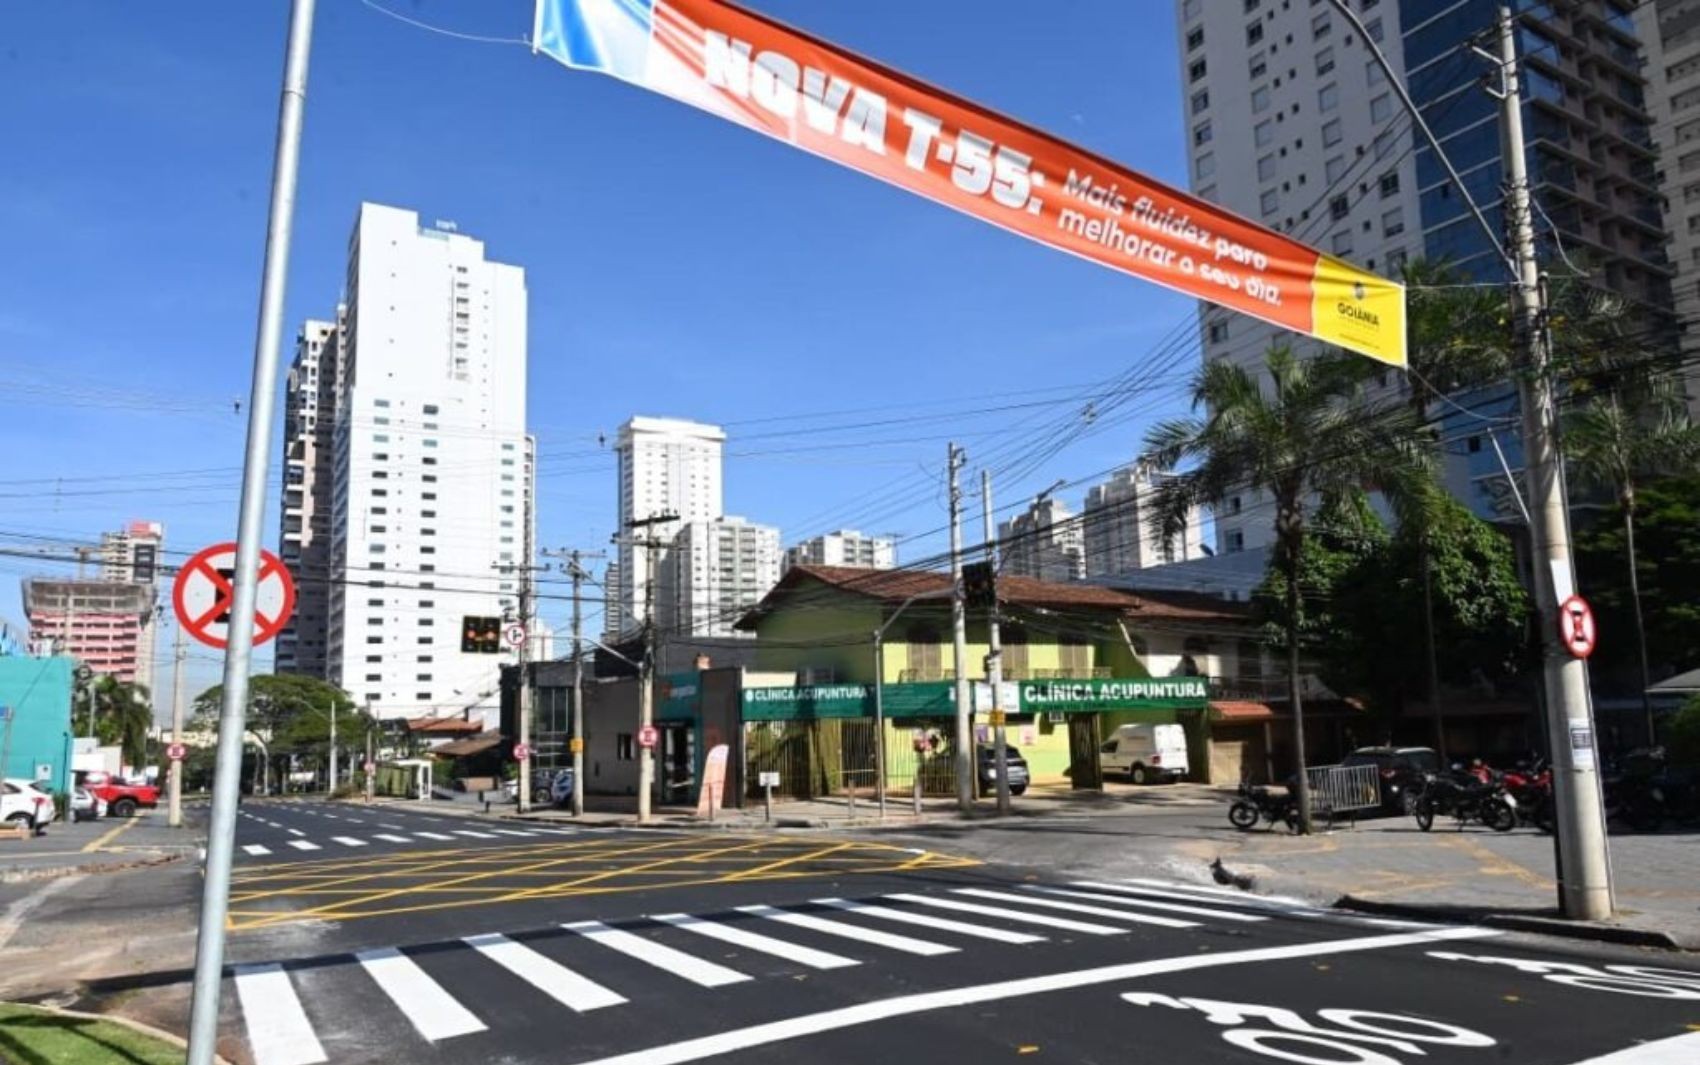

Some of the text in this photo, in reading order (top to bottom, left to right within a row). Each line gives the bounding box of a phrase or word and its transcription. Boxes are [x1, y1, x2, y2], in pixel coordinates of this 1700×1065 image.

[704, 28, 888, 156] NOVA
[1061, 168, 1128, 217] Mais
[1131, 195, 1212, 250] fluidez
[1058, 207, 1177, 266] melhorar
[1199, 262, 1241, 291] seu
[1337, 301, 1381, 326] GOIÂNIA
[755, 688, 795, 701] CLÍNICA
[796, 685, 867, 700] ACUPUNTURA
[1023, 680, 1206, 702] CLÍNICA ACUPUNTURA
